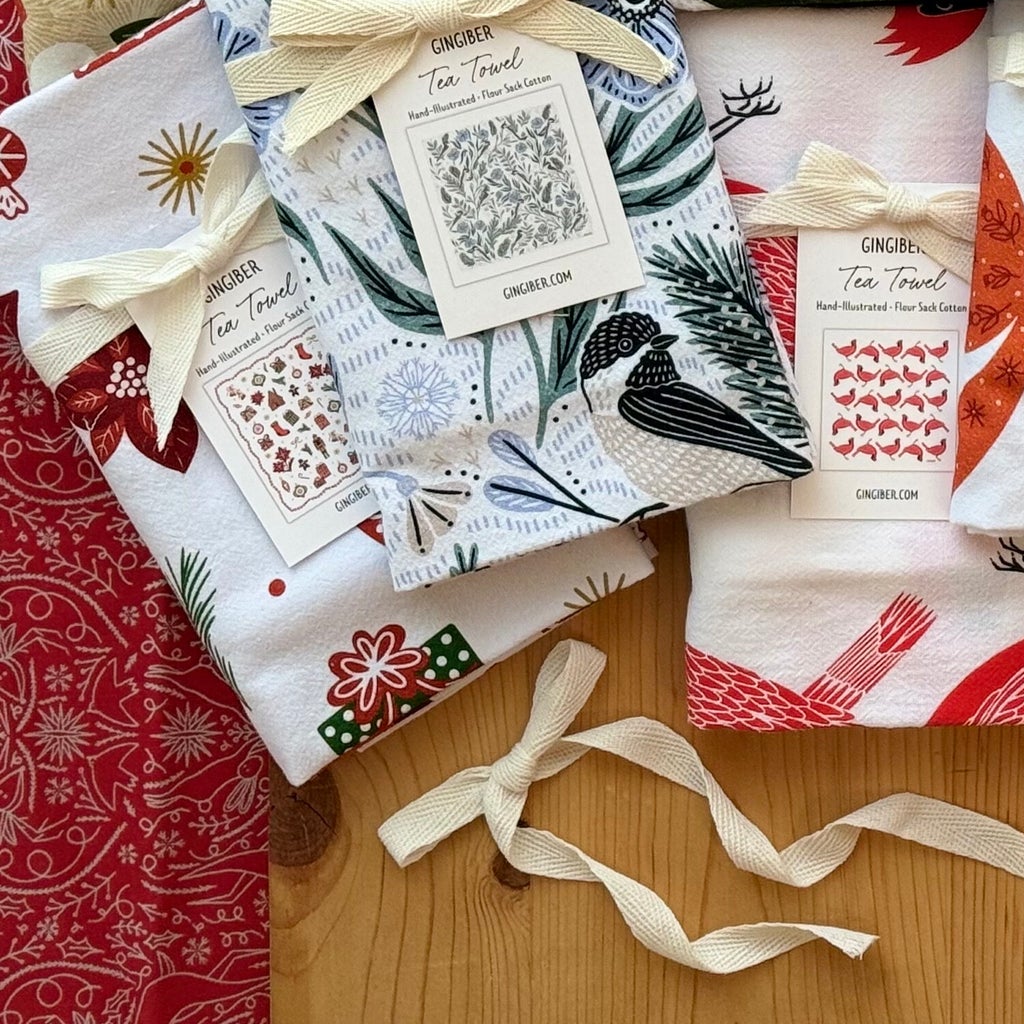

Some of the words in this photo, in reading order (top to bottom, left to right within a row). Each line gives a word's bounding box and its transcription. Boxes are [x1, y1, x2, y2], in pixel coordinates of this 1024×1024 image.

[431, 25, 495, 54] GINGIBER
[418, 66, 461, 96] Tea
[461, 46, 523, 83] Towel
[408, 94, 476, 121] Hand-Illustrated
[482, 89, 503, 100] Flour
[504, 83, 523, 94] Sack
[524, 75, 552, 89] Cotton
[503, 270, 573, 300] GINGIBER.COM
[839, 265, 879, 292] Tea
[885, 266, 947, 292] Towel
[201, 312, 239, 346] Tea
[236, 272, 298, 321] Towel
[817, 301, 887, 311] Hand-Illustrated
[895, 302, 917, 311] Flour
[918, 302, 937, 312] Sack
[940, 302, 967, 312] Cotton
[195, 331, 261, 378] Hand-Illustrated
[264, 319, 286, 335] Flour
[287, 308, 305, 322] Sack
[856, 489, 918, 500] GINGIBER.COM
